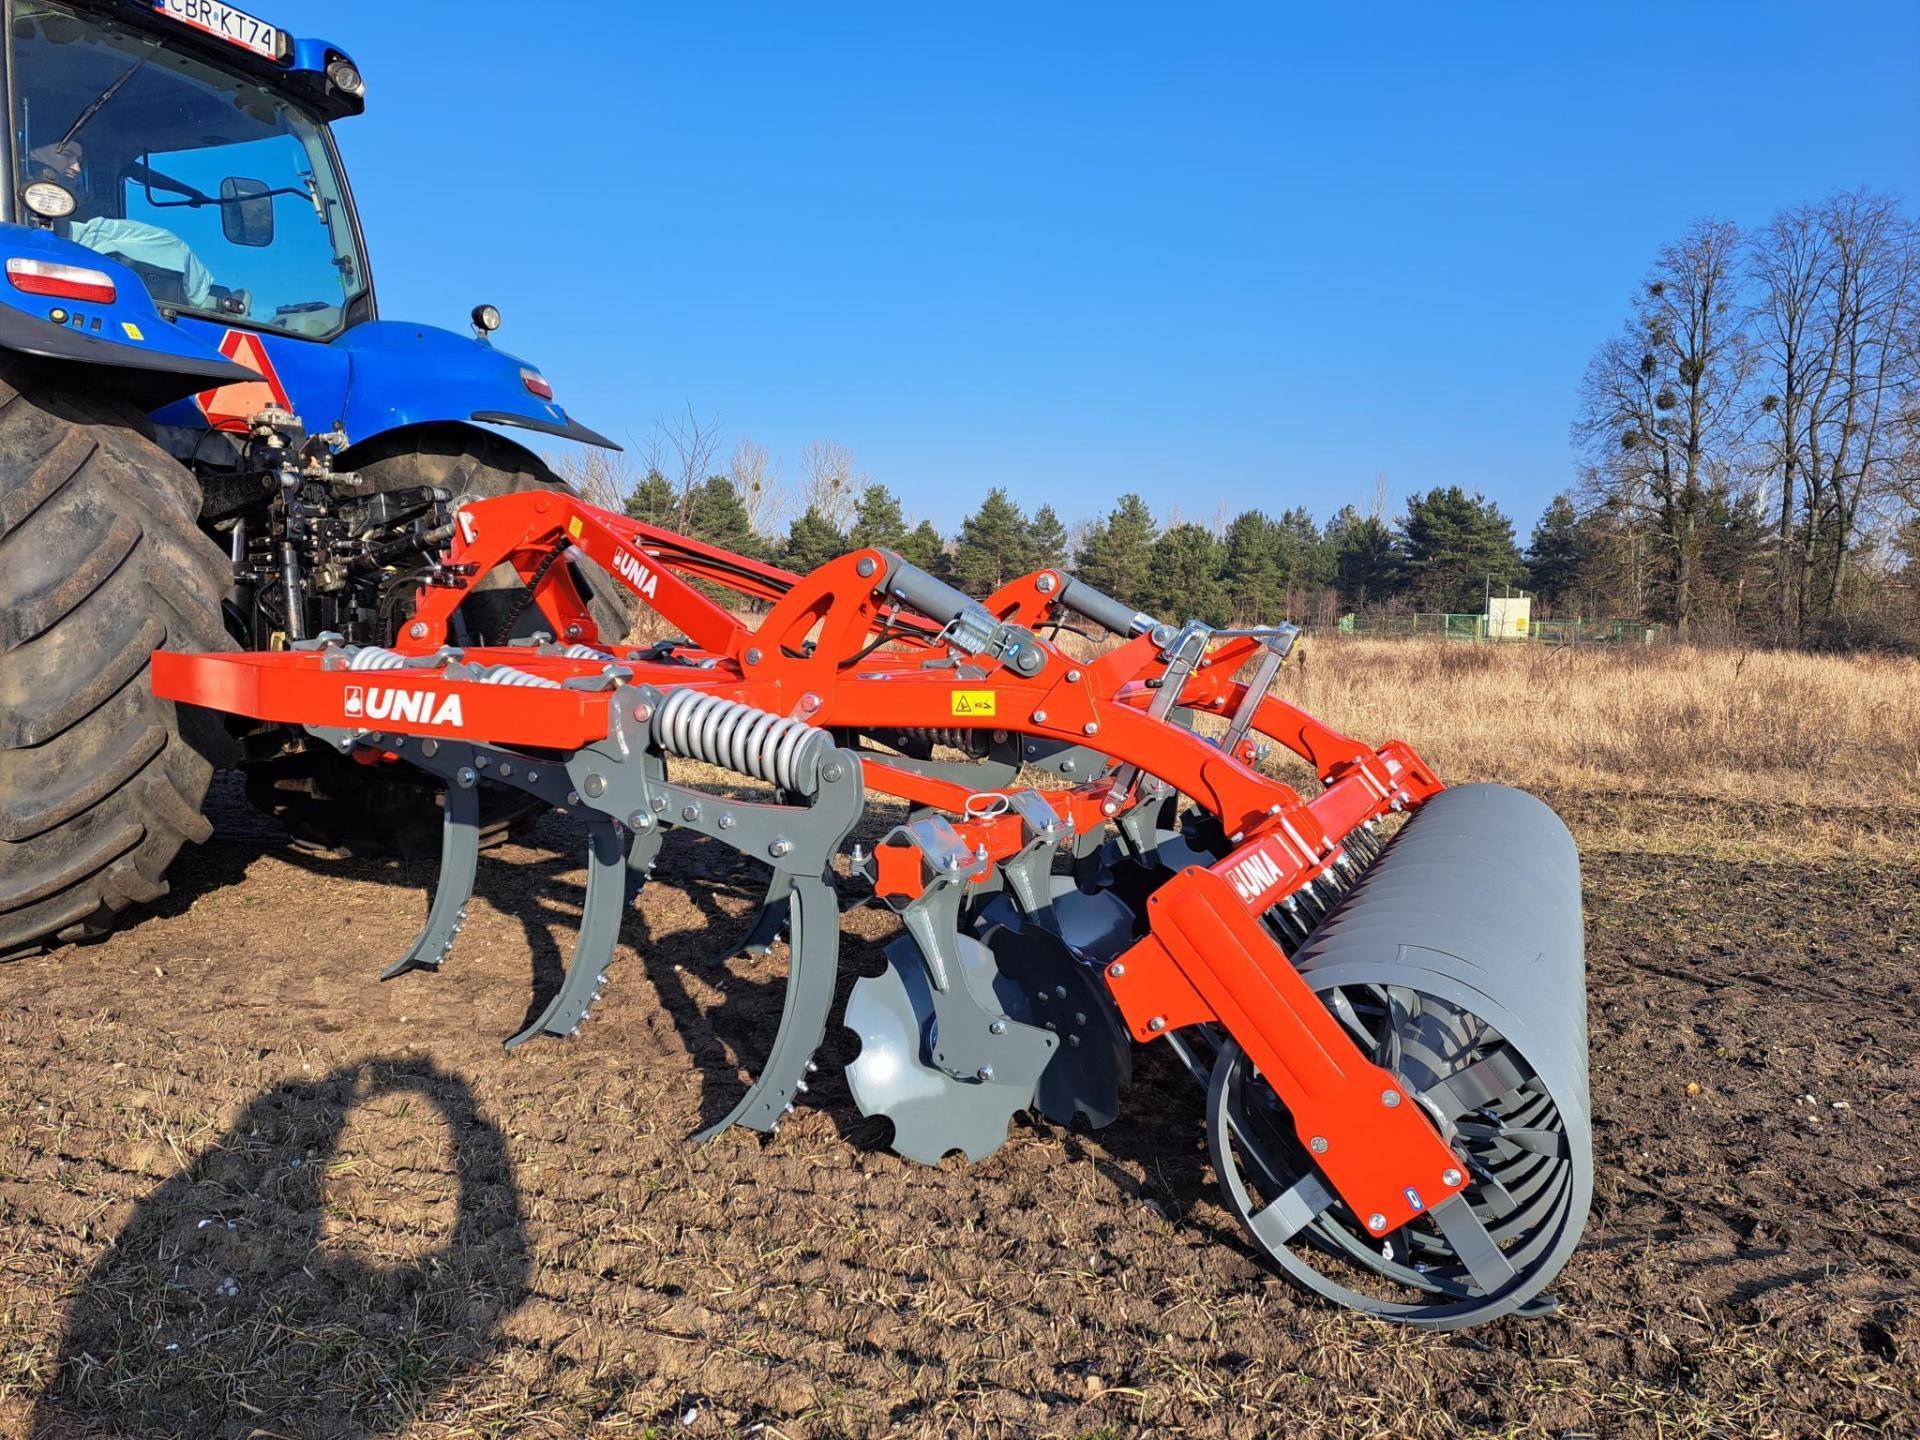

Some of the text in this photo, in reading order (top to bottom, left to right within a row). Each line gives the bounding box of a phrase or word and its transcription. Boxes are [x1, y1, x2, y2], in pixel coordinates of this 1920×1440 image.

[220, 8, 272, 51] KT74
[620, 552, 658, 600] UNIA
[365, 687, 464, 727] UNIA
[1234, 849, 1284, 897] UNIA
